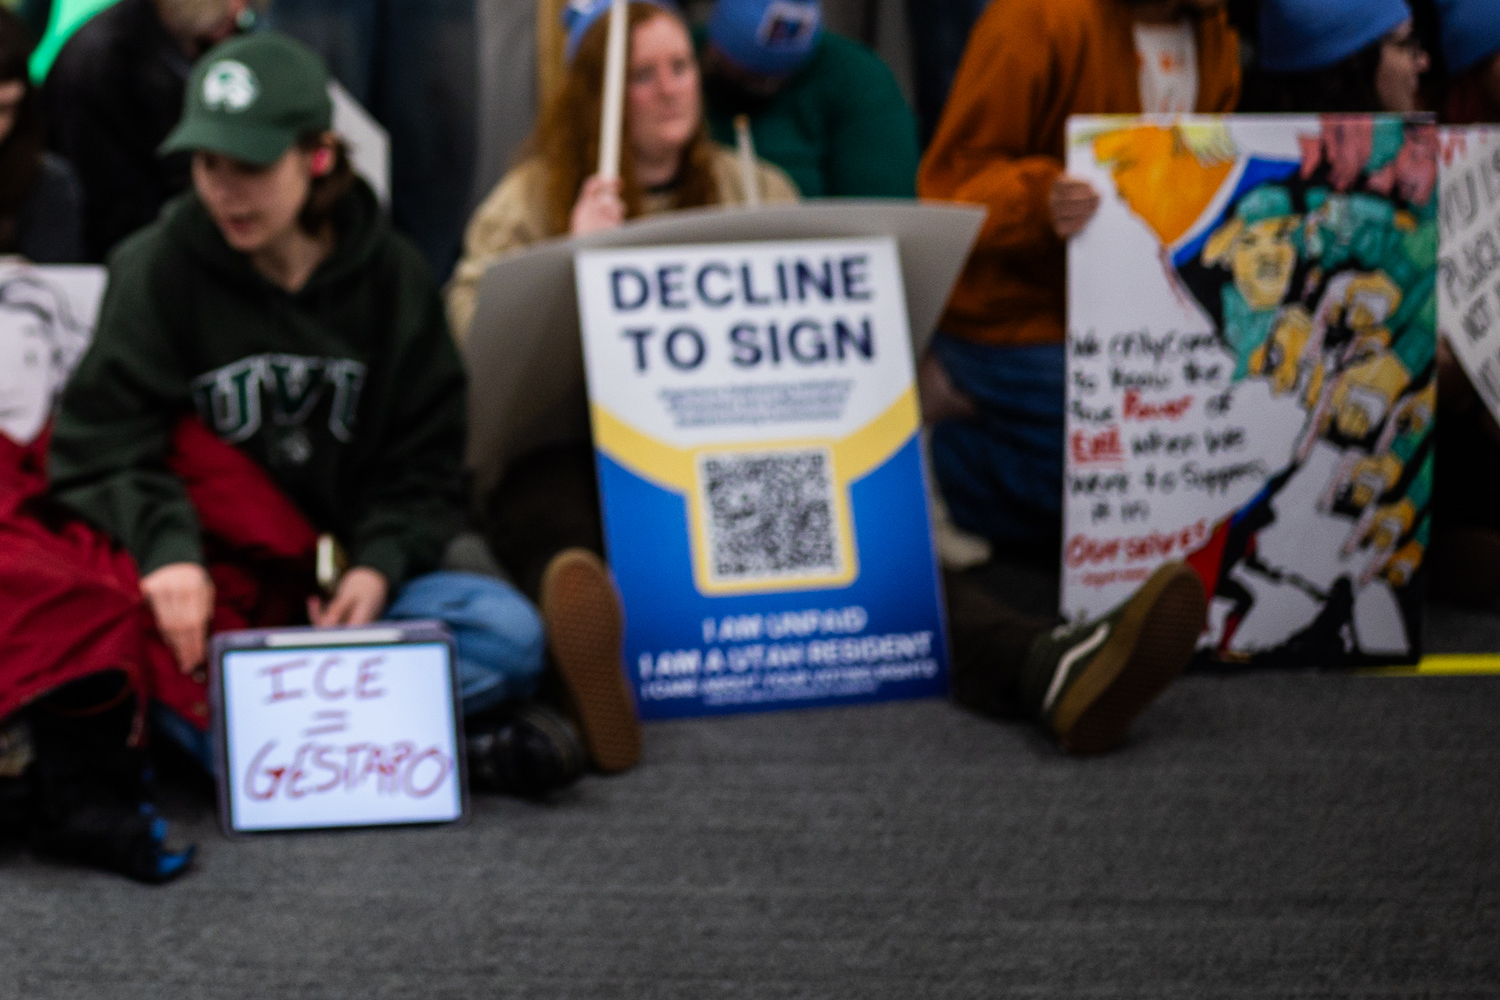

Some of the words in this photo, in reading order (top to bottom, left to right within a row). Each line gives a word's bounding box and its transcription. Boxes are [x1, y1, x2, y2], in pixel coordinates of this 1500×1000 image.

[608, 254, 874, 312] DECLINE
[623, 324, 708, 374] TO
[728, 316, 876, 370] SIGN
[702, 616, 716, 644] I
[718, 613, 763, 643] AM
[764, 604, 869, 640] UNPAID
[257, 655, 388, 704] ICE
[638, 651, 652, 680] I
[655, 648, 701, 678] AM
[704, 646, 726, 674] A
[727, 642, 806, 673] UTAH
[807, 630, 933, 664] RESIDENT
[243, 738, 452, 803] GESTAPO
